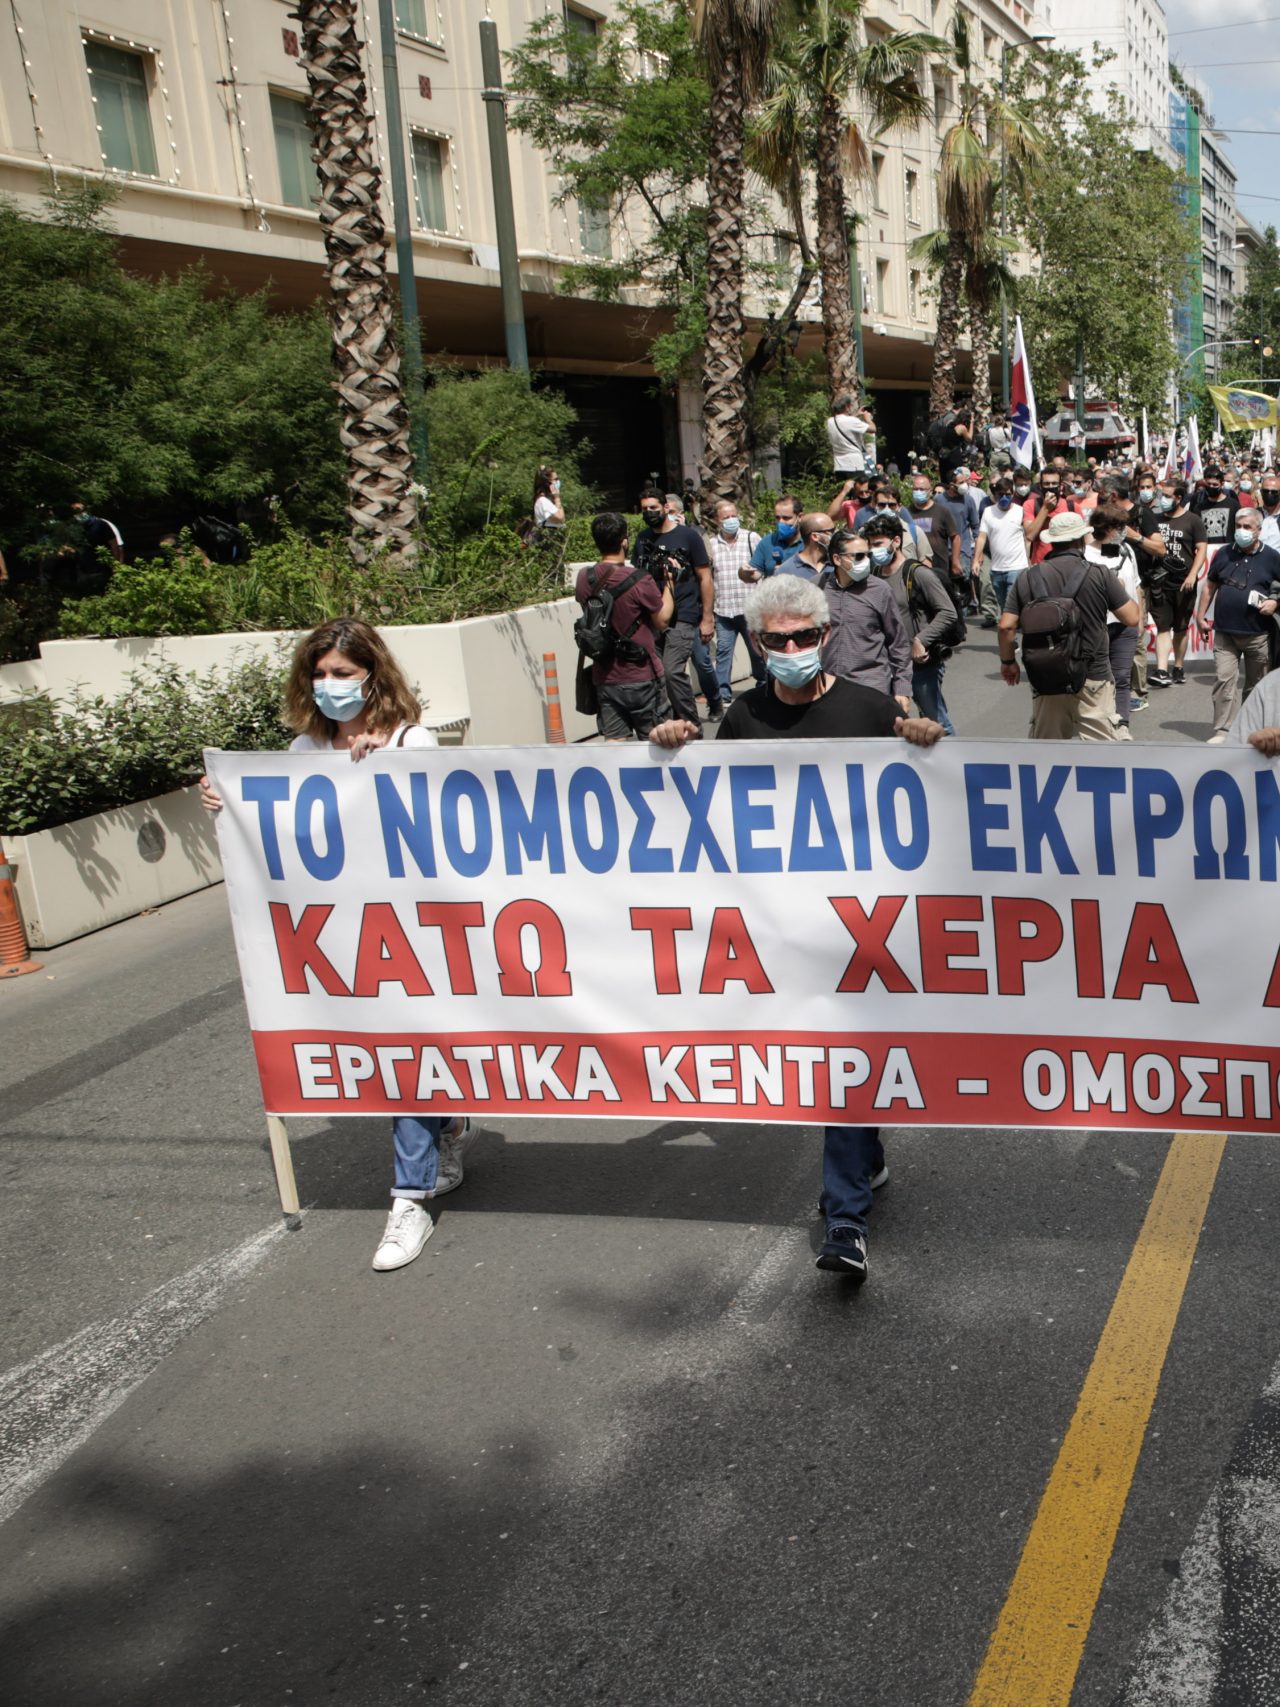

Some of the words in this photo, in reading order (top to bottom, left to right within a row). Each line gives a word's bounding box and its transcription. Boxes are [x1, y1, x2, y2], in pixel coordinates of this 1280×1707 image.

[242, 774, 345, 881] ΤΟ
[374, 762, 930, 879] ΝΟΜΟΣΧΕΔΙΟ
[268, 898, 573, 999] ΚΑΤΩ
[629, 906, 776, 995] ΤΑ
[828, 894, 1200, 1005] ΧΕΡΙΑ
[292, 1042, 622, 1102] ΕΡΓΑΤΙΚΑ
[642, 1044, 926, 1110] ΚΕΝΤΡΑ
